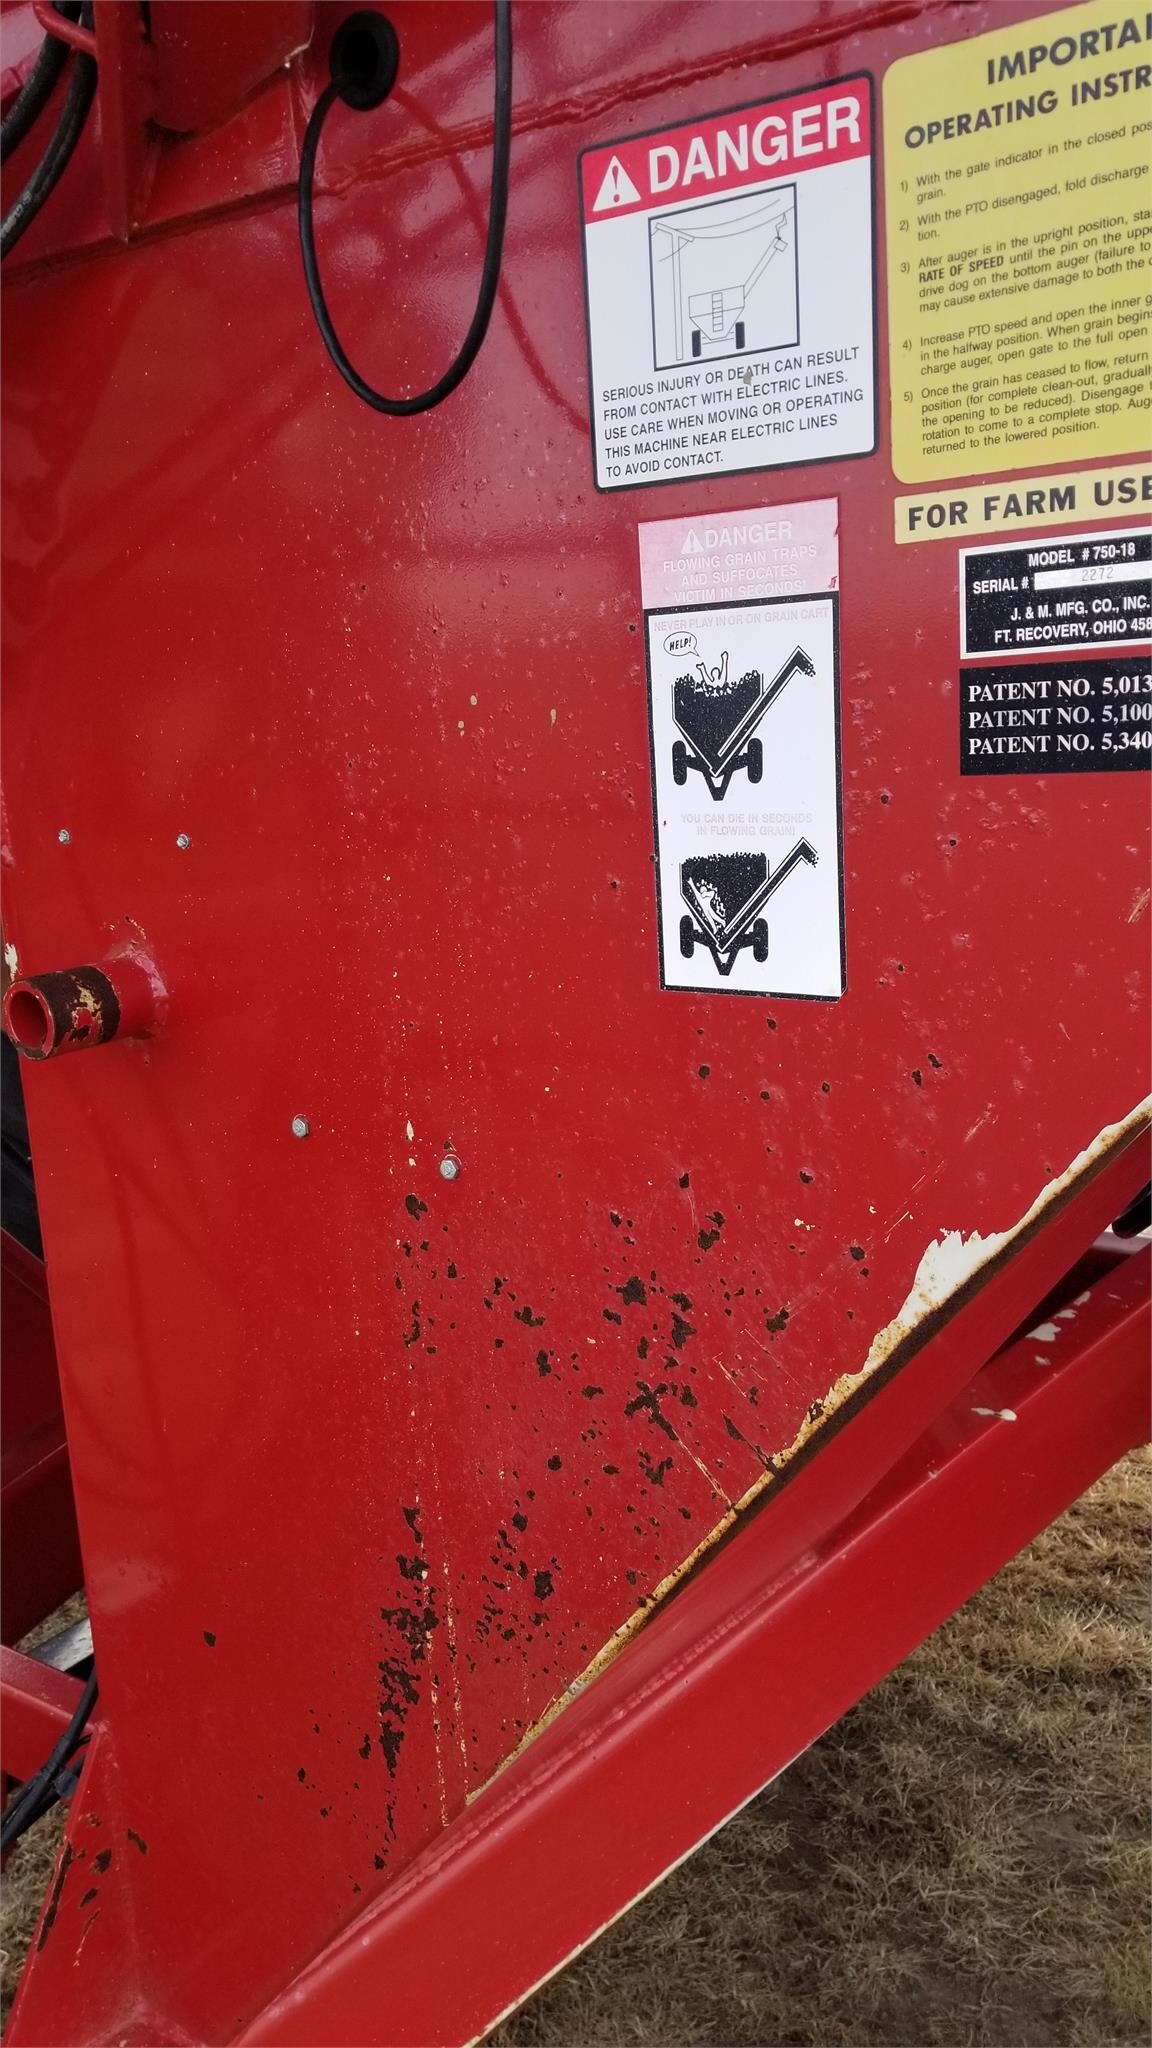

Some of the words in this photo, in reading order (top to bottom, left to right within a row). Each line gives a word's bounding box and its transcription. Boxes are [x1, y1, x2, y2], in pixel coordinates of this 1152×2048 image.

[905, 91, 1058, 148] OPERATING
[650, 97, 860, 194] DANGER
[900, 181, 908, 192] 1)
[917, 174, 940, 187] With
[945, 168, 961, 181] the
[967, 162, 990, 177] gate
[995, 148, 1042, 168] indicator
[1049, 144, 1058, 154] in
[1064, 138, 1082, 150] the
[1087, 129, 1125, 145] closed
[900, 220, 909, 232] 2)
[918, 214, 941, 226] With
[945, 208, 961, 220] the
[966, 201, 988, 215] PTO
[992, 185, 1060, 209] disengaged,
[1066, 179, 1086, 192] fold
[1091, 164, 1148, 186] discharge
[917, 189, 946, 204] grain.
[901, 262, 910, 273] 3)
[918, 255, 942, 268] After
[947, 247, 978, 263] auger
[982, 245, 991, 254] is
[996, 242, 1006, 251] in
[1011, 236, 1028, 248] the
[1034, 226, 1073, 244] upright
[1078, 214, 1127, 234] position,
[918, 229, 940, 241] tion.
[919, 269, 944, 283] RATE
[950, 264, 963, 276] OF
[969, 256, 1004, 272] SPEED
[1010, 251, 1033, 264] until
[1038, 246, 1055, 258] the
[1061, 242, 1078, 254] pin
[1083, 238, 1097, 247] on
[1103, 231, 1121, 243] the
[903, 338, 912, 350] 4)
[920, 330, 964, 346] Increase
[968, 324, 990, 337] PTO
[994, 317, 1028, 334] speed
[1032, 313, 1052, 326] and
[1056, 307, 1084, 322] open
[1089, 302, 1107, 315] the
[1112, 296, 1141, 310] inner
[921, 351, 929, 361] in
[933, 347, 949, 359] the
[953, 340, 992, 356] halfway
[996, 332, 1043, 348] position.
[1047, 324, 1080, 338] When
[1084, 317, 1113, 333] grain
[603, 383, 653, 402] SERIOUS
[657, 374, 700, 393] INJURY
[705, 371, 723, 384] OR
[728, 362, 769, 383] DEATH
[774, 356, 802, 373] CAN
[807, 347, 859, 367] RESULT
[904, 391, 913, 402] 5)
[921, 386, 949, 399] Once
[952, 383, 968, 393] the
[972, 377, 999, 392] grain
[1003, 373, 1022, 384] has
[1026, 364, 1066, 380] ceased
[1070, 361, 1080, 373] to
[1084, 358, 1109, 370] flow,
[1114, 351, 1148, 366] return
[604, 404, 637, 421] FROM
[640, 395, 696, 415] CONTACT
[701, 390, 732, 405] WITH
[737, 378, 800, 400] ELECTRIC
[805, 370, 848, 389] LINES.
[921, 398, 962, 415] position
[966, 394, 983, 408] (for
[988, 384, 1037, 402] complete
[1042, 376, 1098, 392] clean-out,
[631, 420, 663, 436] CARE
[667, 414, 703, 431] WHEN
[708, 406, 758, 424] MOVING
[763, 403, 781, 416] OR
[786, 389, 864, 412] OPERATING
[923, 427, 960, 441] rotation
[965, 424, 974, 434] to
[979, 419, 1008, 432] come
[1013, 416, 1023, 427] to
[1028, 415, 1034, 424] a
[1039, 406, 1090, 423] complete
[1095, 401, 1122, 415] stop.
[605, 442, 630, 459] THIS
[634, 433, 688, 455] MACHINE
[693, 431, 726, 446] NEAR
[731, 421, 794, 441] ELECTRIC
[800, 414, 837, 430] LINES
[606, 466, 621, 478] TO
[625, 457, 660, 475] AVOID
[664, 451, 723, 469] CONTACT.
[909, 500, 968, 530] FOR
[984, 485, 1076, 521] FARM
[705, 521, 792, 548] DANGER
[664, 556, 720, 572] FLOWING
[725, 552, 767, 566] GRAIN
[773, 545, 816, 559] TRAPS
[1028, 549, 1074, 567] MODEL
[682, 574, 707, 587] AND
[712, 564, 798, 584] SUFFOCATES
[973, 578, 1018, 594] SERIAL
[1082, 567, 1114, 582] 2272
[674, 589, 715, 603] VICTIM
[720, 586, 734, 598] IN
[1011, 608, 1021, 621] J.
[1026, 607, 1034, 619] &
[1038, 604, 1051, 618] M.
[1056, 600, 1088, 617] MFG.
[1092, 598, 1119, 613] CO.,
[1123, 595, 1150, 610] INC.
[654, 619, 687, 631] NEVER
[689, 617, 713, 628] PLAY
[716, 616, 725, 626] IN
[728, 614, 743, 625] OR
[746, 613, 761, 623] ON
[765, 609, 798, 622] GRAIN
[801, 607, 829, 619] CART
[995, 630, 1012, 643] FT.
[1016, 622, 1089, 642] RECOVERY,
[1093, 619, 1126, 634] OHIO
[670, 637, 691, 651] HELP!
[968, 681, 1051, 702] PATENT
[1057, 679, 1095, 697] NO.
[969, 708, 1051, 728] PATENT
[1057, 706, 1095, 724] NO.
[969, 735, 1050, 755] PATENT
[1056, 734, 1095, 751] NO.
